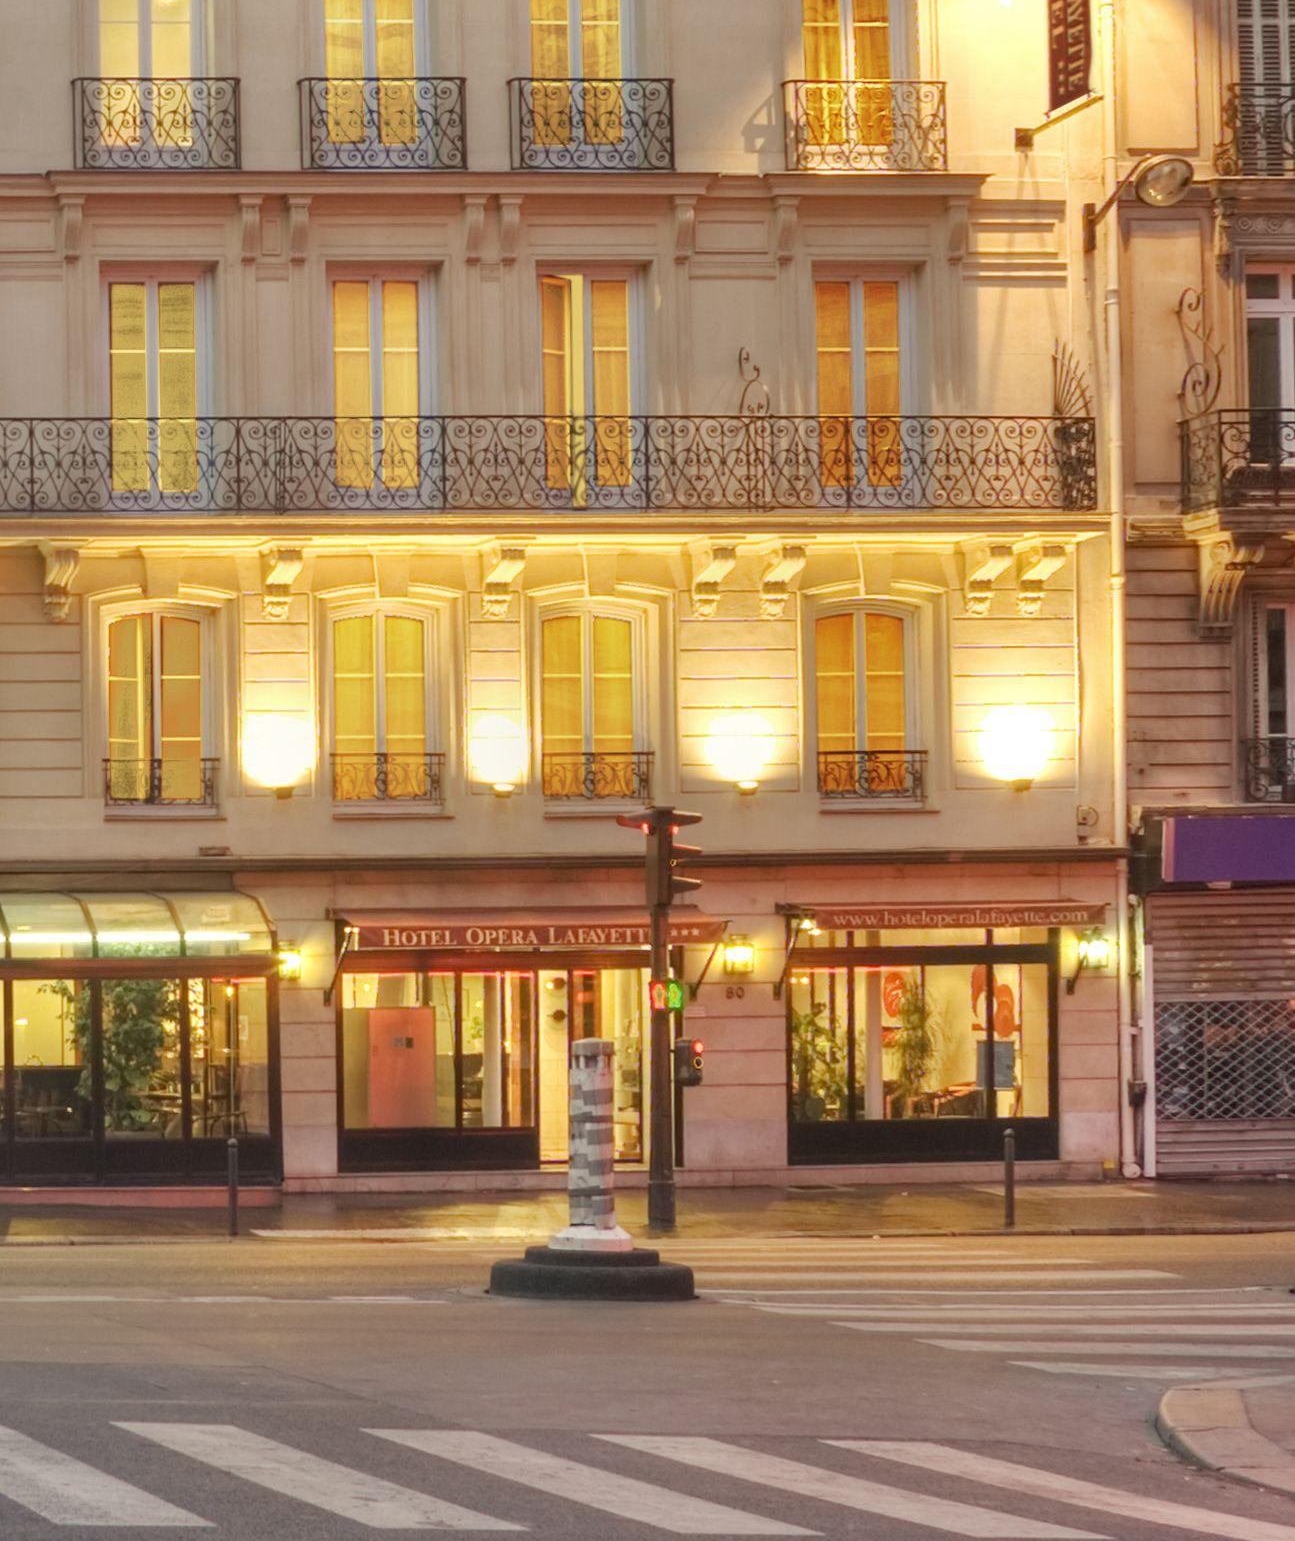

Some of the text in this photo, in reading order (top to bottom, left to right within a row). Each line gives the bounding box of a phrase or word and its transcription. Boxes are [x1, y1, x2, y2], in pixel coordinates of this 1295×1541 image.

[833, 910, 1088, 929] www.hoteloperalafayette.com
[383, 928, 456, 946] HOTEL
[548, 926, 650, 944] LAFAYETT
[726, 986, 744, 999] 80
